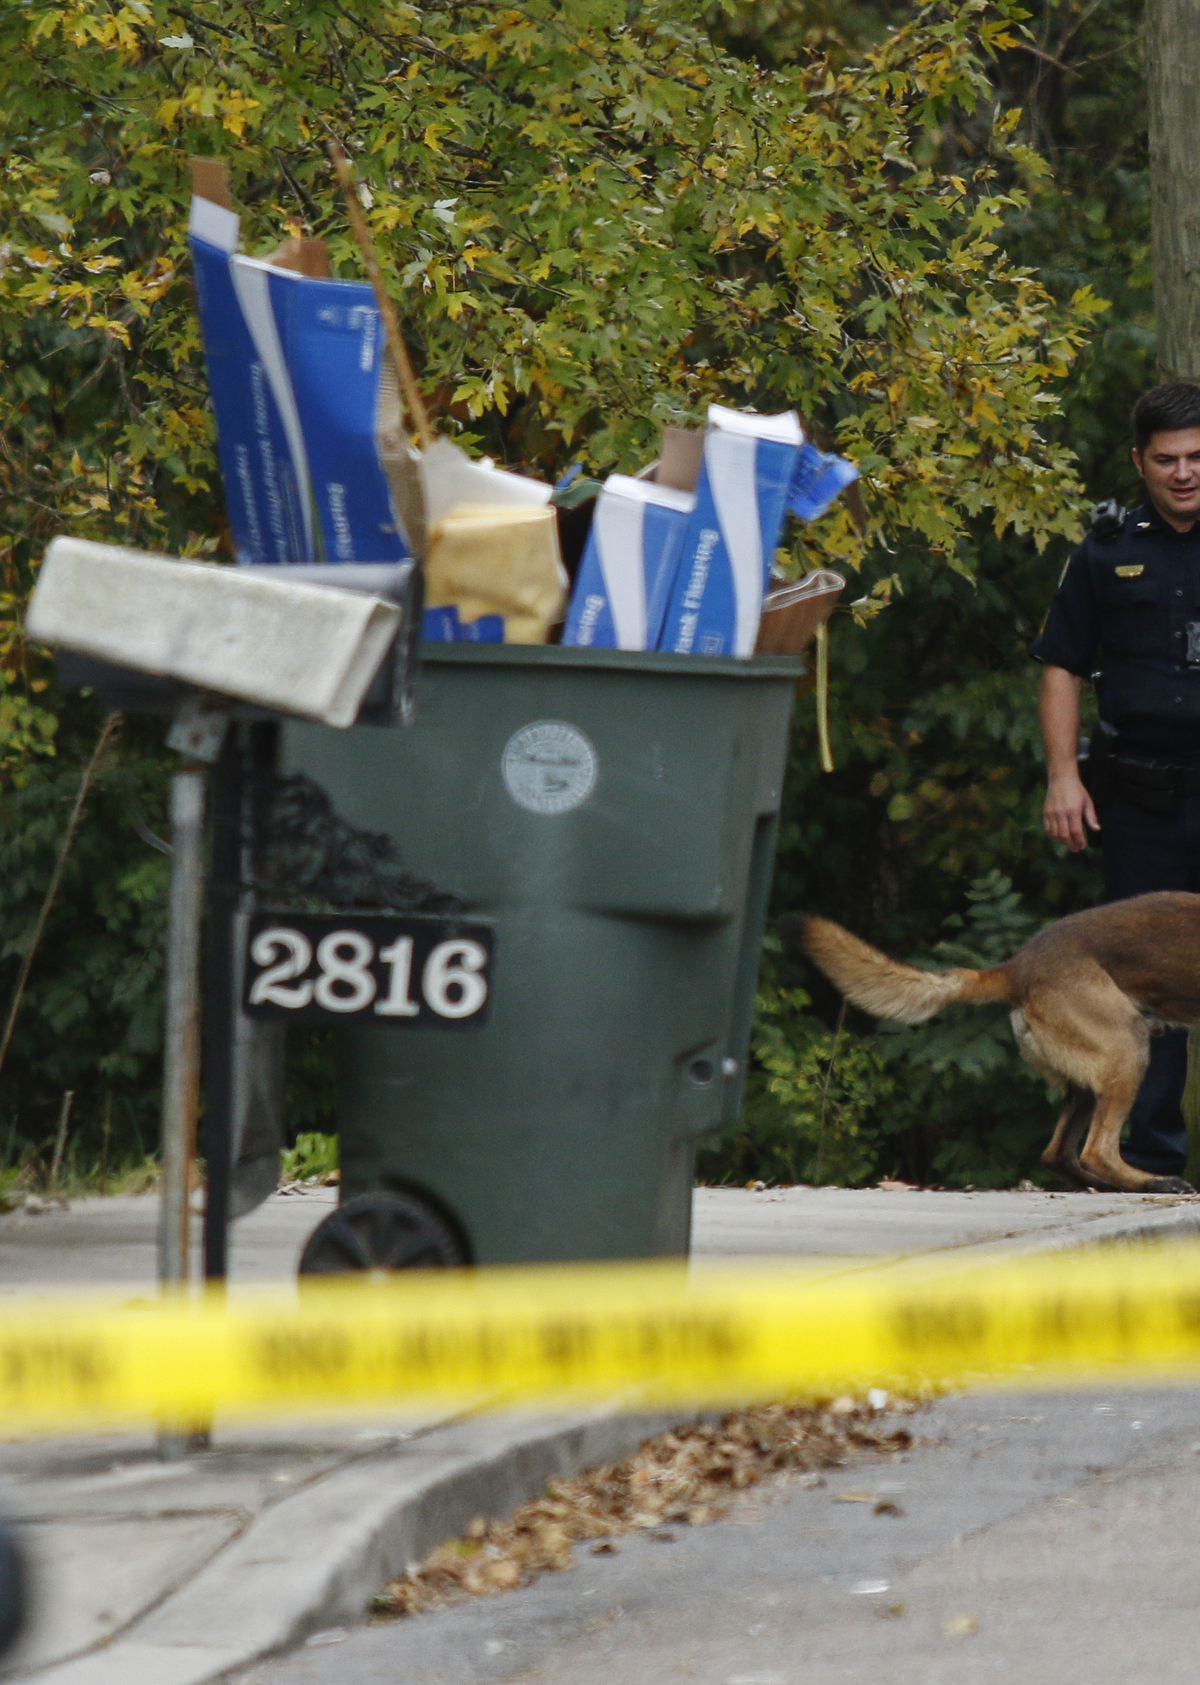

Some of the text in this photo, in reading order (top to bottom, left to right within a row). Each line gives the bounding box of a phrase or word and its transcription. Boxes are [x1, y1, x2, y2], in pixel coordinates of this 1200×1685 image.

[674, 528, 720, 654] lank Flooring
[249, 926, 488, 1019] 2816
